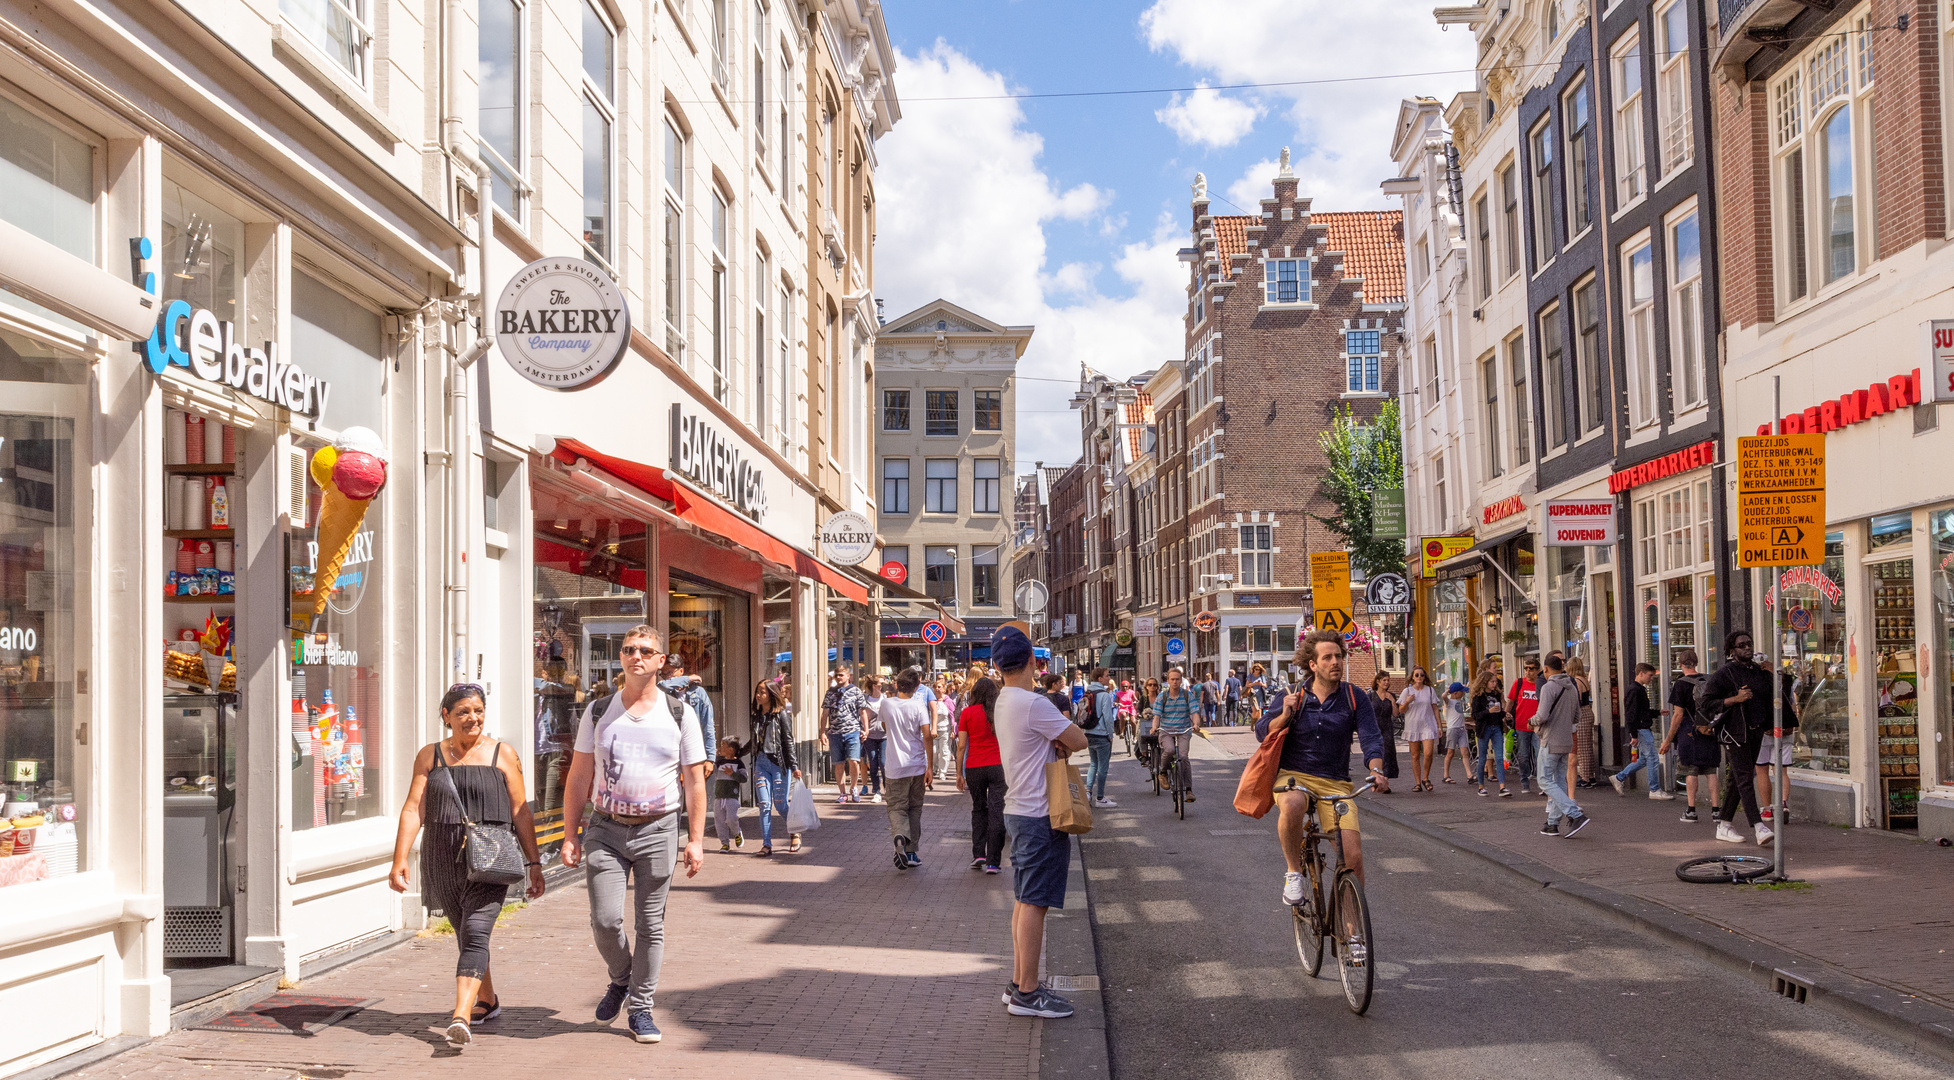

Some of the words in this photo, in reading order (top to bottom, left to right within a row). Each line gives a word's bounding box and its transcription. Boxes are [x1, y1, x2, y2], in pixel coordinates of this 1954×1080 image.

[516, 265, 548, 289] SWEET
[566, 264, 606, 289] SAVORY
[549, 289, 571, 305] The
[499, 308, 621, 335] BAKERY
[528, 335, 592, 353] Company
[524, 365, 594, 382] AMSTERDAM
[1743, 438, 1789, 448] OUDEZIJDS
[672, 403, 740, 504] BAKERY
[1743, 447, 1814, 459] ACHTERBURGWAL
[1608, 441, 1713, 495] SUPERMARKET
[1764, 459, 1776, 468] TS.
[1779, 458, 1793, 467] NR.
[1795, 457, 1823, 466] 93-149
[1743, 468, 1795, 478] AFGESLOTEN
[1797, 468, 1819, 477] I.V.M.
[1744, 477, 1815, 488] WERKZAAMHEDEN
[1744, 496, 1770, 506] LADEN
[1773, 495, 1783, 504] EN
[1786, 494, 1817, 504] LOSSEN
[1374, 509, 1383, 517] &
[1548, 504, 1612, 517] SUPERMARKET
[1744, 506, 1790, 516] OUDEZIJDS
[1744, 515, 1815, 526] ACHTERBURGWAL
[822, 533, 873, 544] BAKERY
[1557, 529, 1606, 542] SOUVENIRS
[1744, 531, 1768, 541] VOLG:
[1777, 529, 1791, 543] A
[307, 531, 374, 574] BERY
[834, 543, 861, 551] Company
[1311, 555, 1346, 563] OMLEIDING
[1764, 566, 1842, 611] SERMARKET
[1389, 604, 1408, 612] SEEDS
[1322, 611, 1339, 630] A
[613, 739, 650, 758] FEEL
[607, 777, 648, 798] GOOD
[602, 793, 650, 816] VIBES
